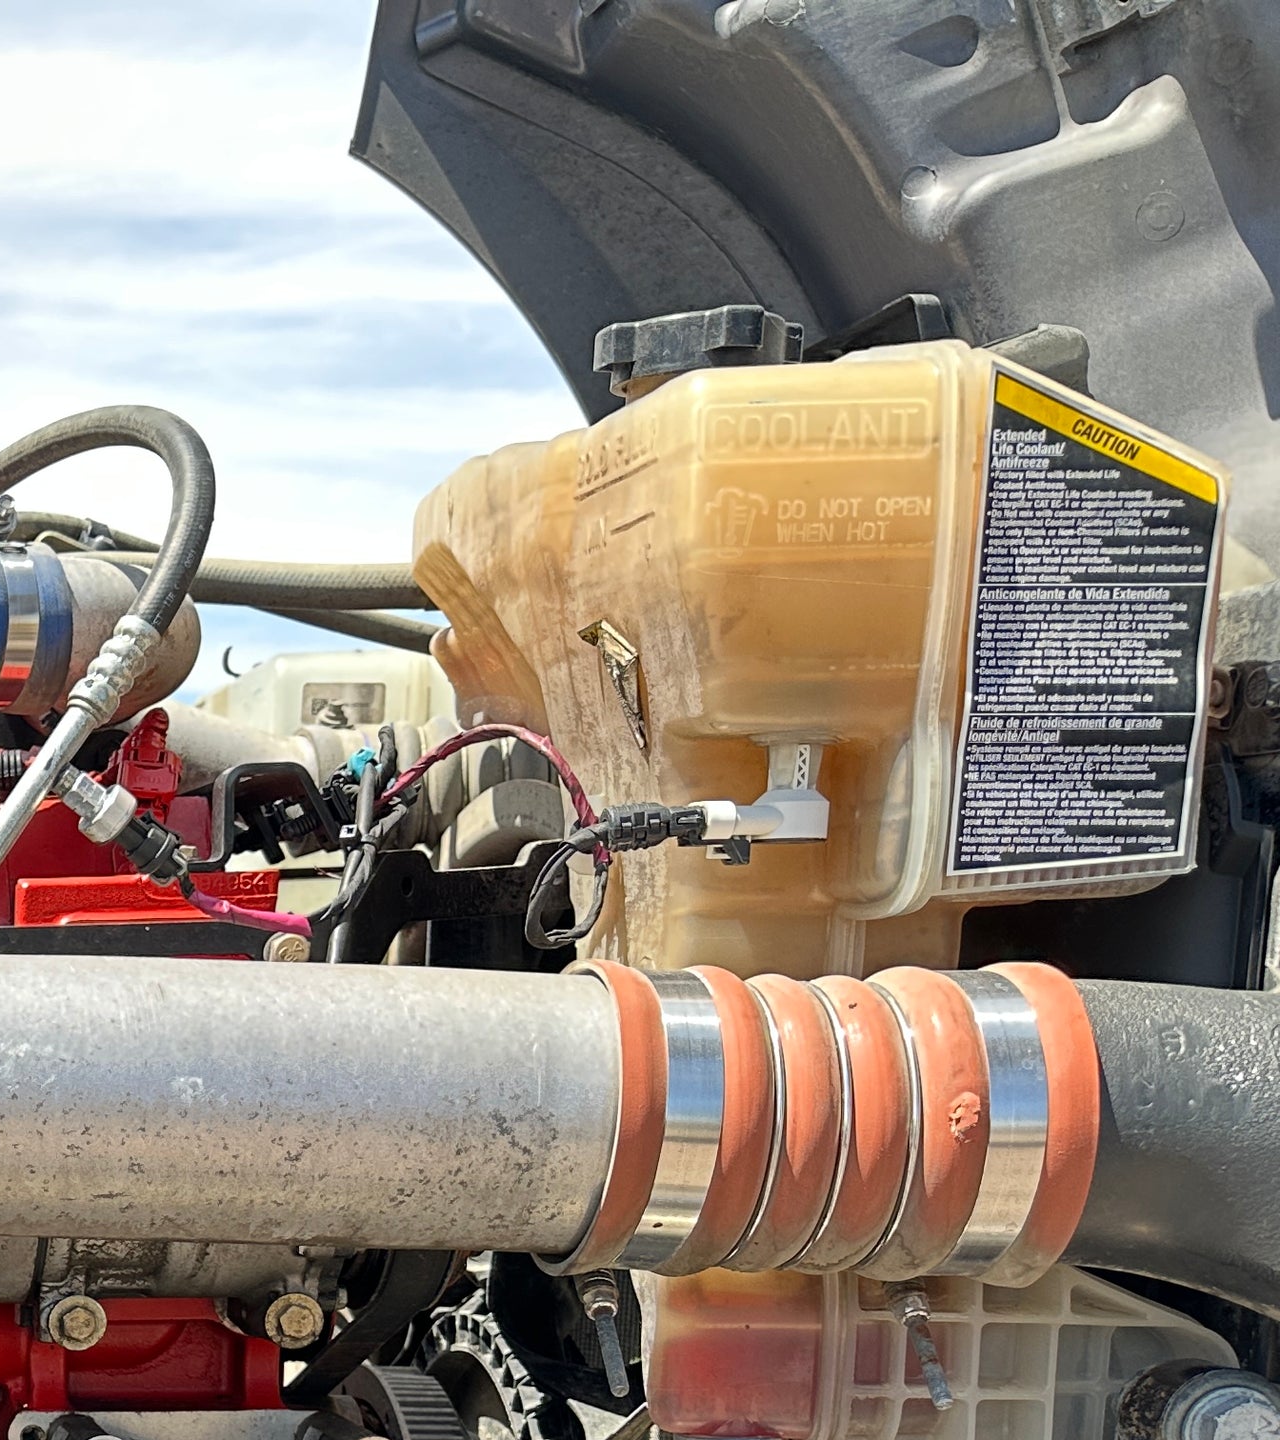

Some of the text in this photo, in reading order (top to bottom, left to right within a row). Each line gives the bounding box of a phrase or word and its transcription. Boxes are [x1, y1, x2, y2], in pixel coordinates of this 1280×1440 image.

[708, 406, 920, 454] COOLANT
[993, 429, 1046, 443] Extended
[1072, 419, 1141, 460] CAUTION
[992, 442, 1065, 455] Life Coolant/
[991, 456, 1049, 469] Antifreeze
[777, 496, 932, 520] DO NOT OPEN
[777, 521, 891, 544] WHEN HOT
[980, 588, 1170, 602] Anticongelante de Vida Extendida
[970, 717, 1163, 730] Fluide de refroidissement de grande
[968, 729, 1060, 743] longévité/Antigel
